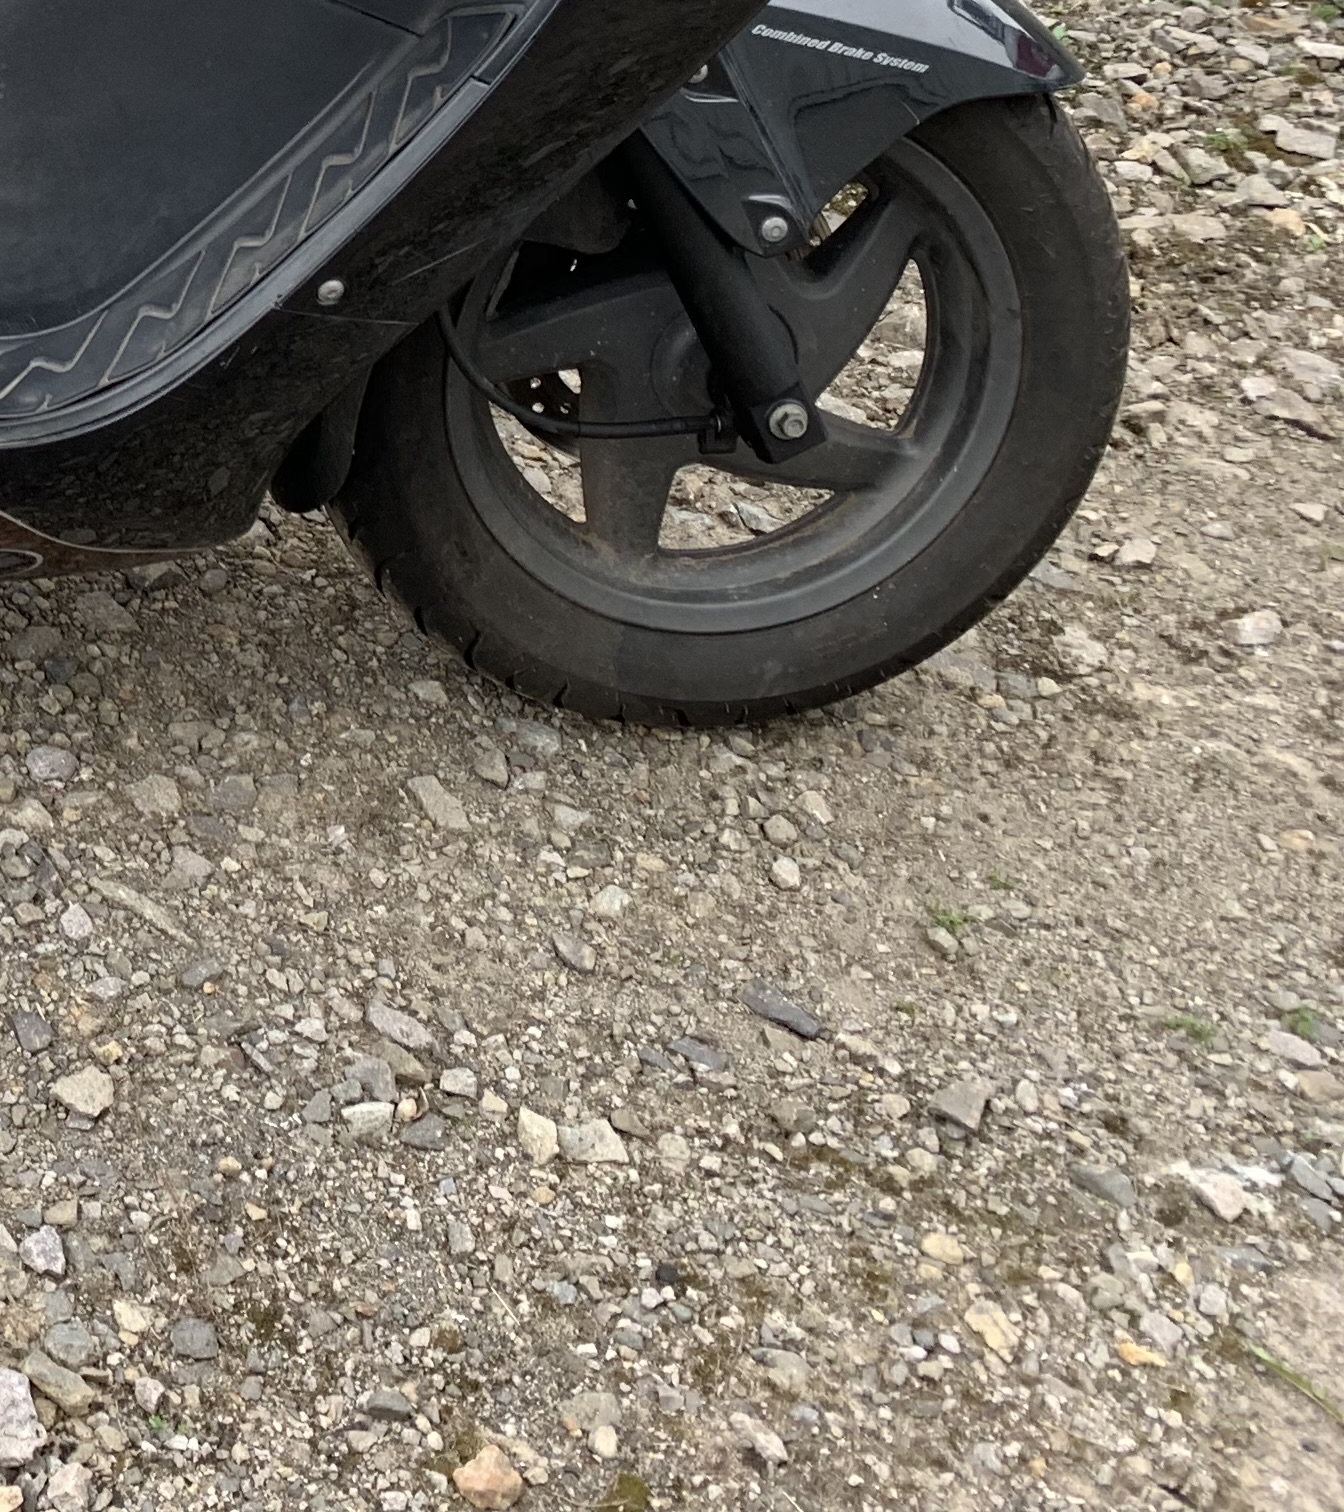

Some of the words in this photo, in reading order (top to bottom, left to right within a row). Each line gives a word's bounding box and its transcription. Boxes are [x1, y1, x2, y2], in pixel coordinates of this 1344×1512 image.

[751, 24, 830, 51] Combined
[827, 42, 874, 61] Brake
[873, 52, 930, 74] System
